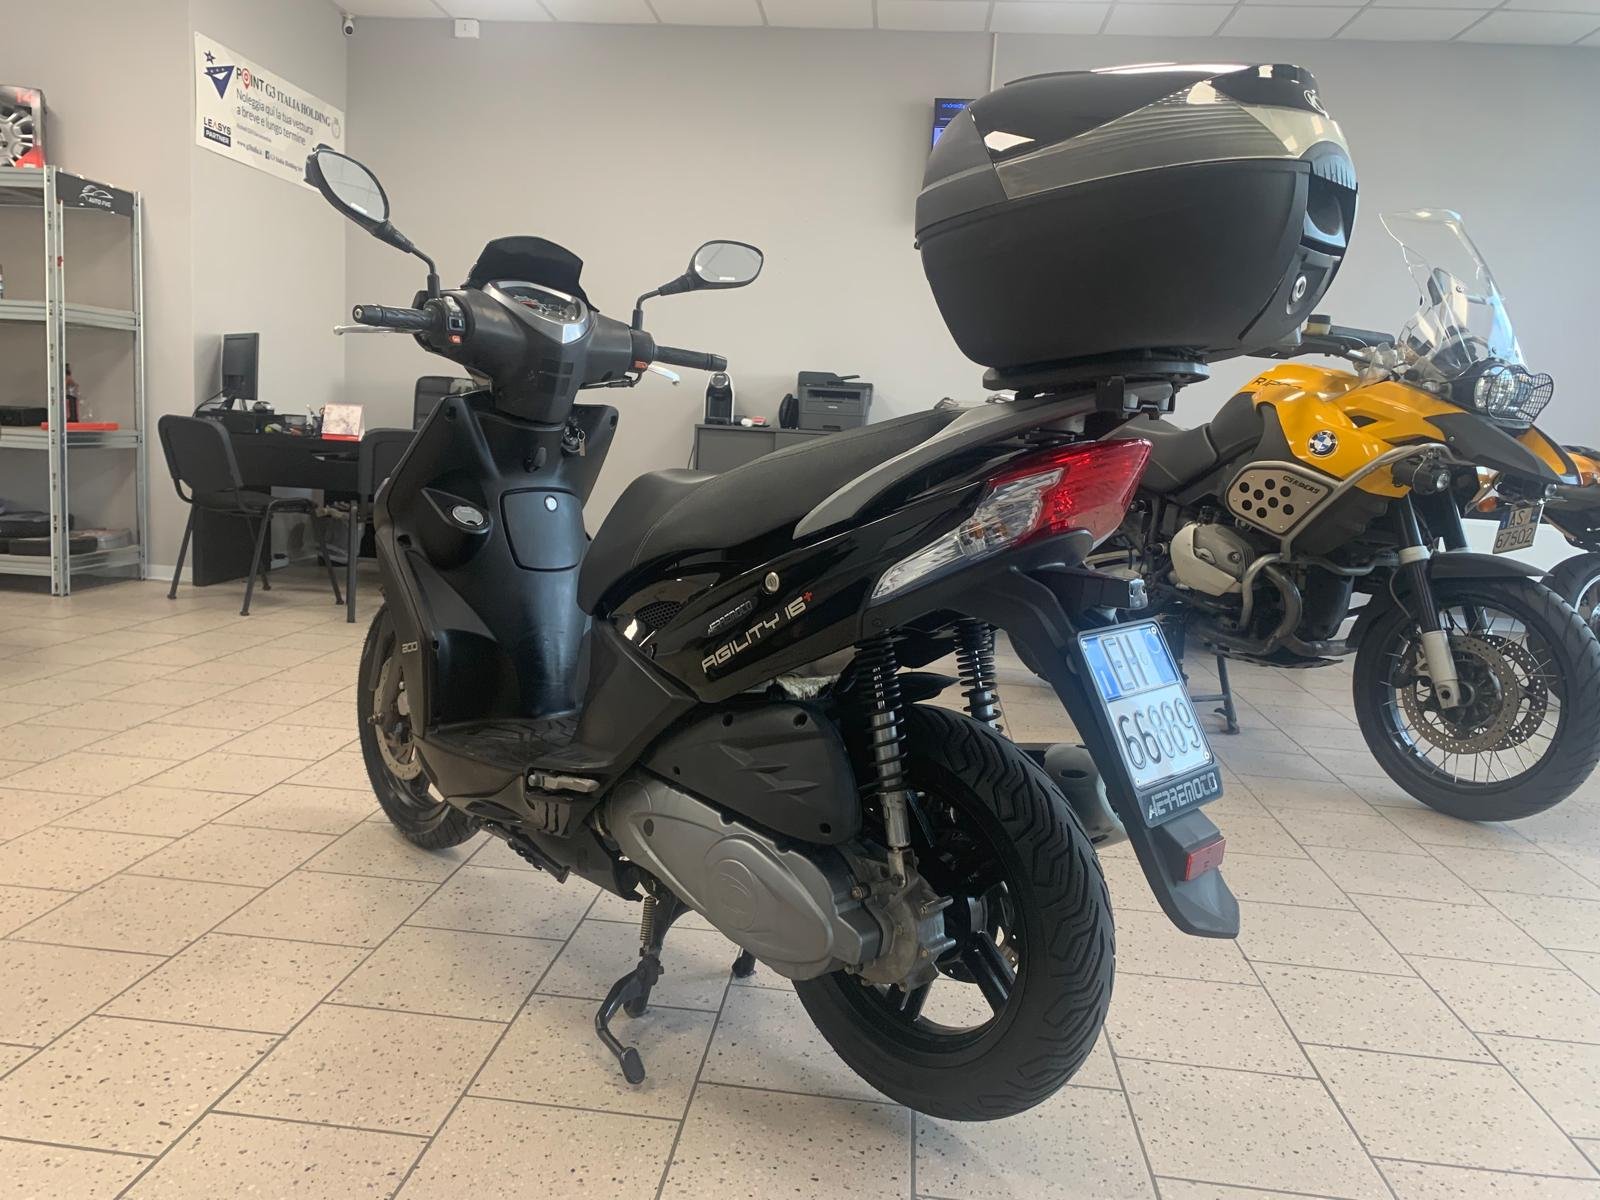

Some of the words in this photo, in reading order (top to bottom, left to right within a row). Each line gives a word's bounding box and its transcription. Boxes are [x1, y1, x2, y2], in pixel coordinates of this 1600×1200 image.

[236, 67, 265, 92] POINT
[265, 83, 276, 99] G3
[277, 90, 301, 112] ITALIA
[301, 102, 331, 127] HOLDING
[236, 87, 265, 112] Noleggia
[265, 105, 276, 119] qui
[282, 111, 292, 126] tua
[292, 118, 314, 136] vettura
[203, 116, 232, 136] LEASYS
[205, 129, 231, 146] PARTNER
[241, 105, 260, 124] breve
[265, 116, 282, 136] lungo
[282, 127, 306, 146] termine
[701, 612, 780, 674] AGILITY
[1117, 697, 1202, 770] 66889
